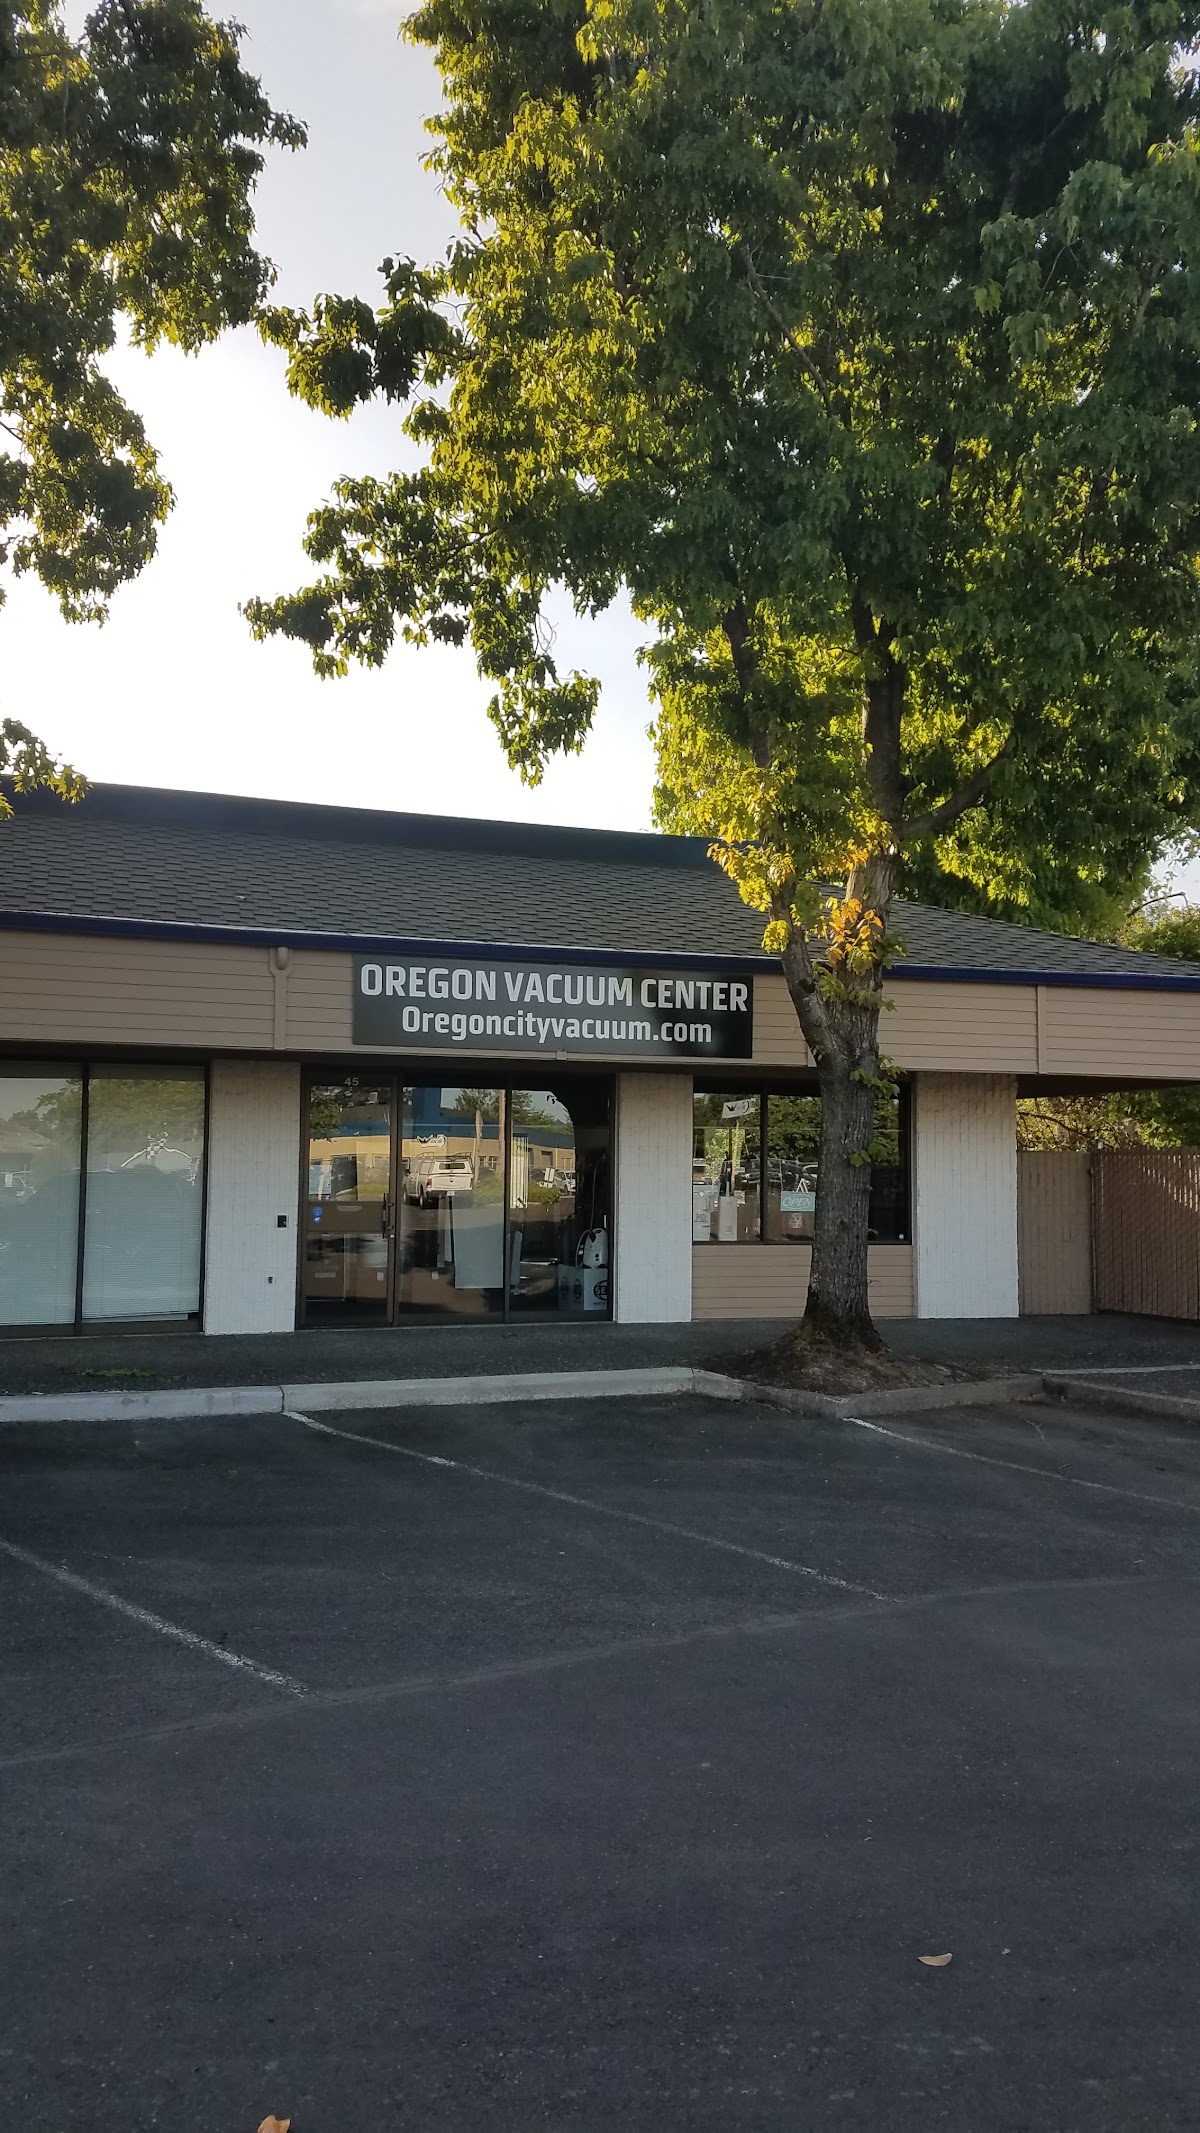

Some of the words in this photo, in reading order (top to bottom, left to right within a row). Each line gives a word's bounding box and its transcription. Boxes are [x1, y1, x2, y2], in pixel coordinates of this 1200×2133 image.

[360, 963, 496, 1001] OREGON
[504, 971, 633, 1007] VACUUM
[640, 978, 748, 1012] CENTER
[402, 1005, 712, 1044] Oregoncityvacuum.com
[344, 1077, 359, 1086] 45
[783, 1197, 811, 1207] OPEN
